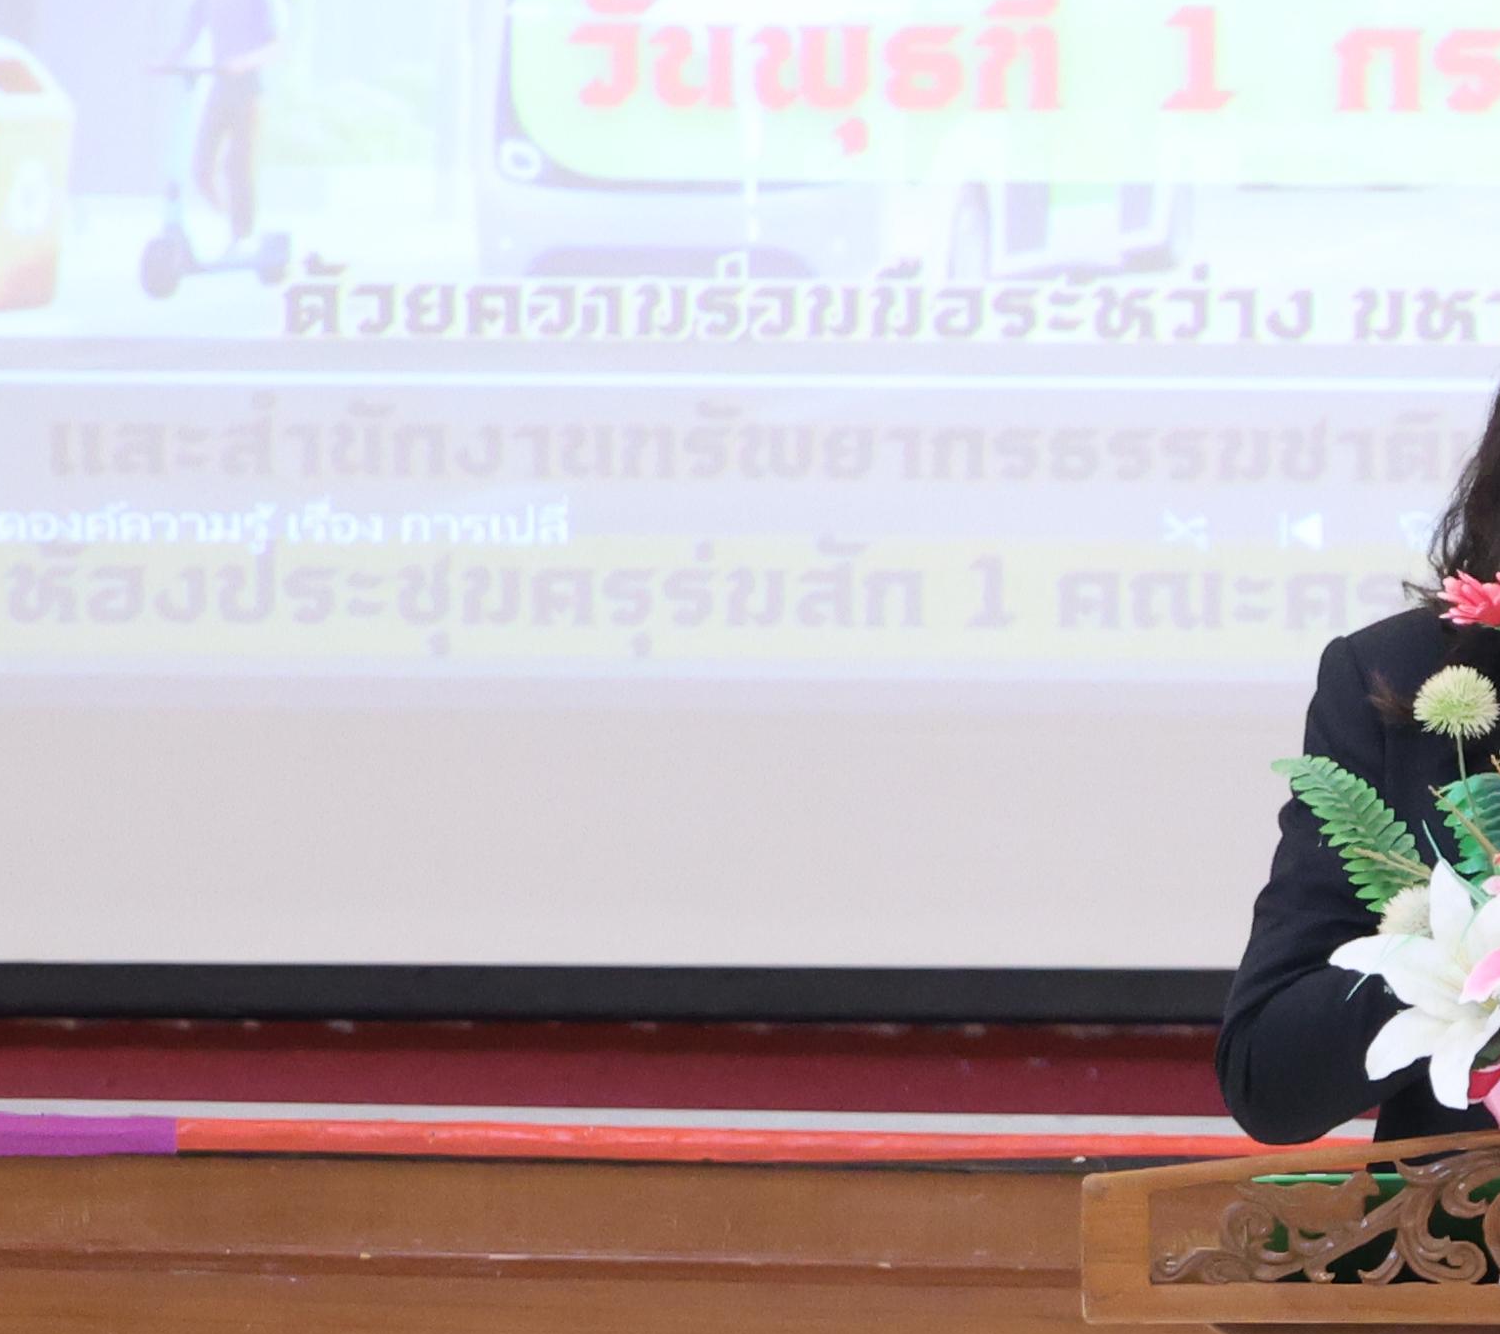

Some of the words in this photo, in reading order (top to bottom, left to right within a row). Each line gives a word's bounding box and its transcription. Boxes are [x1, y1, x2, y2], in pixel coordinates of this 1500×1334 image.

[1161, 6, 1234, 113] 1
[282, 254, 1314, 342] ด้วยความร่วมมือระหว่าง
[286, 495, 383, 544] เรื่อง
[5, 539, 925, 659] ห้องประชุมครุร่มสัก
[965, 554, 1016, 629] 1
